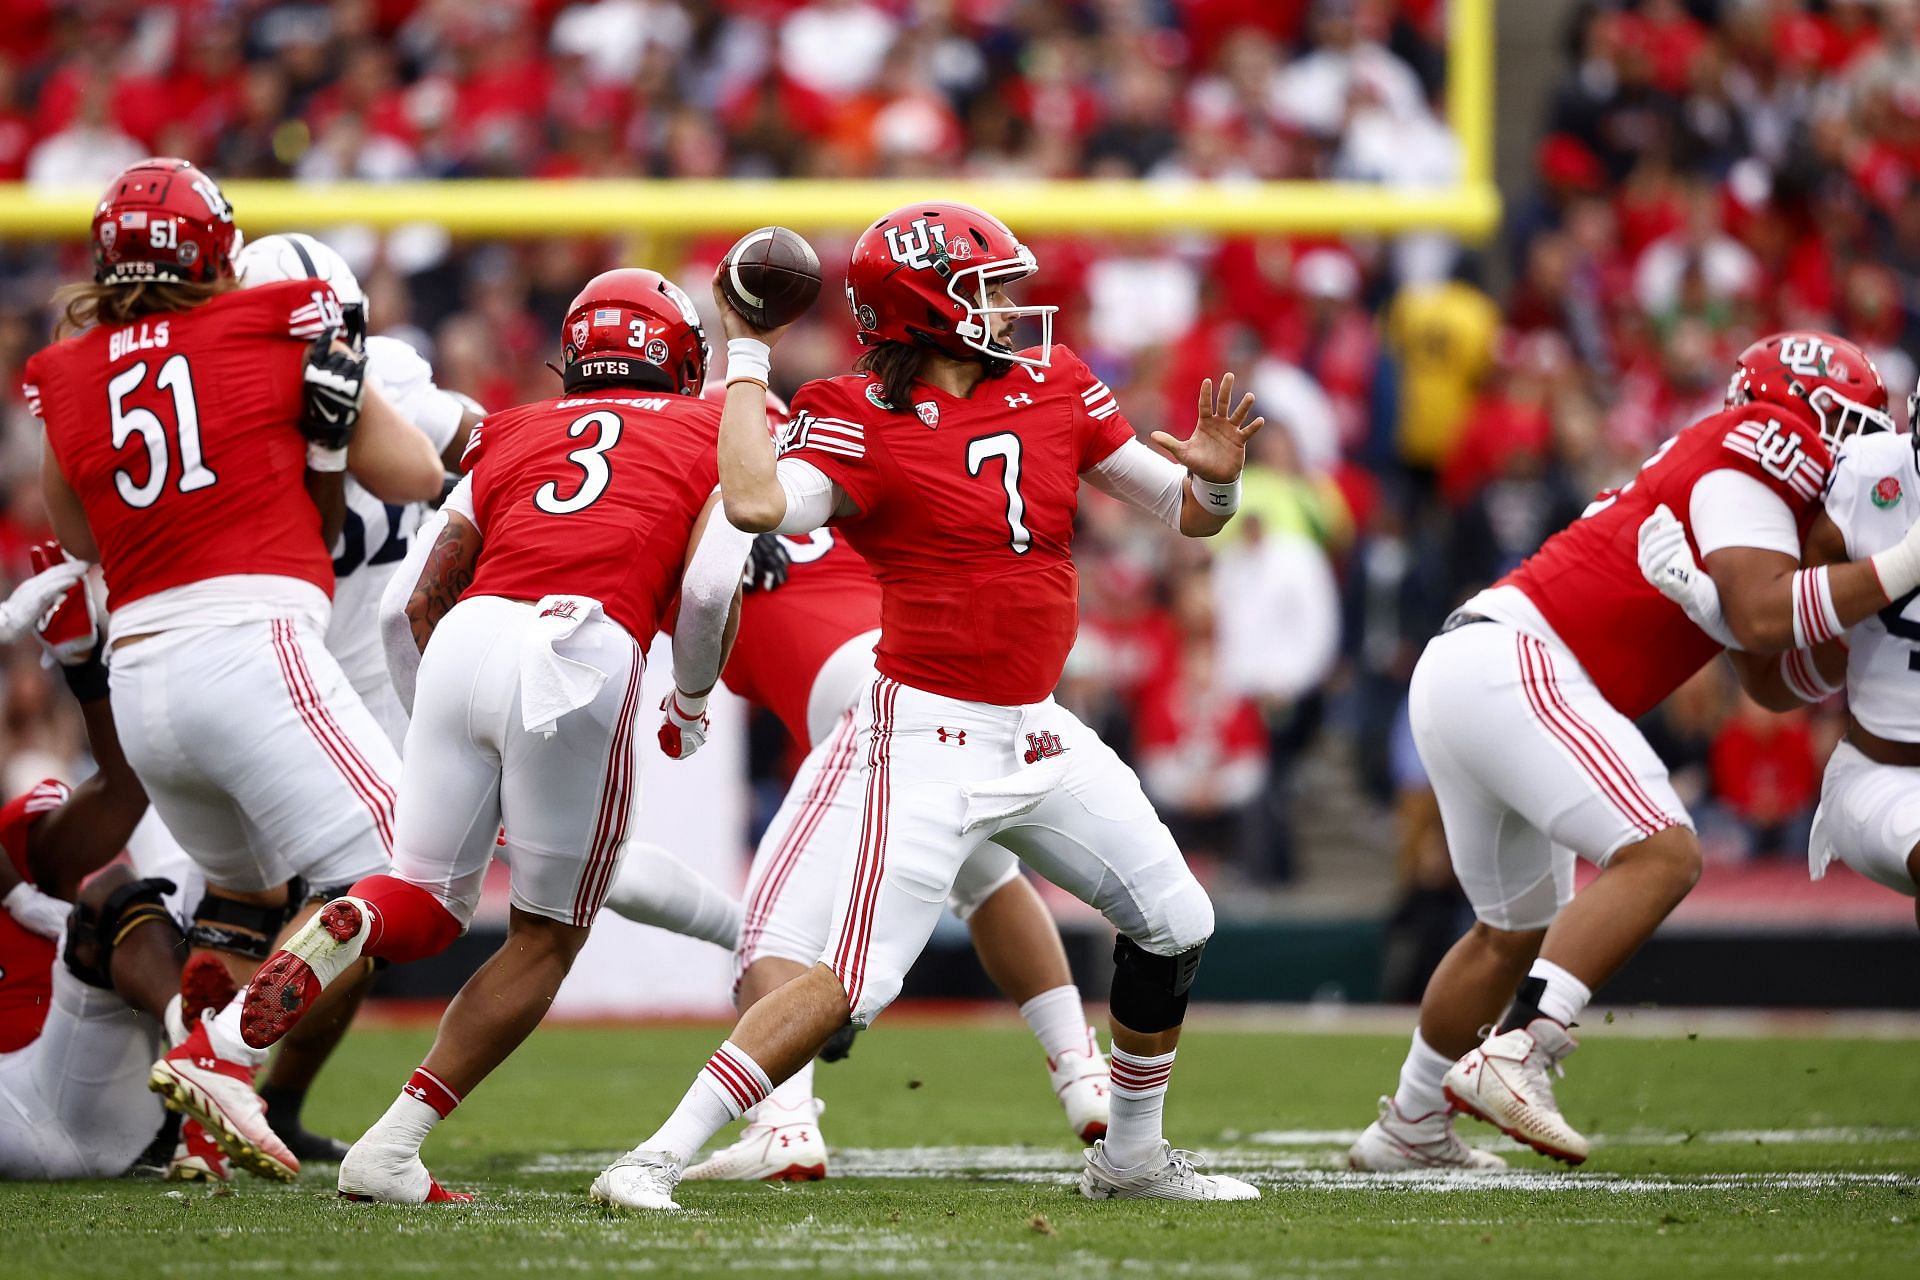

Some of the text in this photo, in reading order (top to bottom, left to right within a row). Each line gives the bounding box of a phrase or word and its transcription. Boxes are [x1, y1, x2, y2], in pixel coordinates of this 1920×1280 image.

[149, 220, 178, 249] 51
[109, 320, 170, 362] BILLS
[627, 319, 647, 348] 3
[581, 361, 630, 377] UTES
[108, 353, 218, 509] 51
[534, 409, 624, 516] 3
[966, 431, 1033, 557] 7
